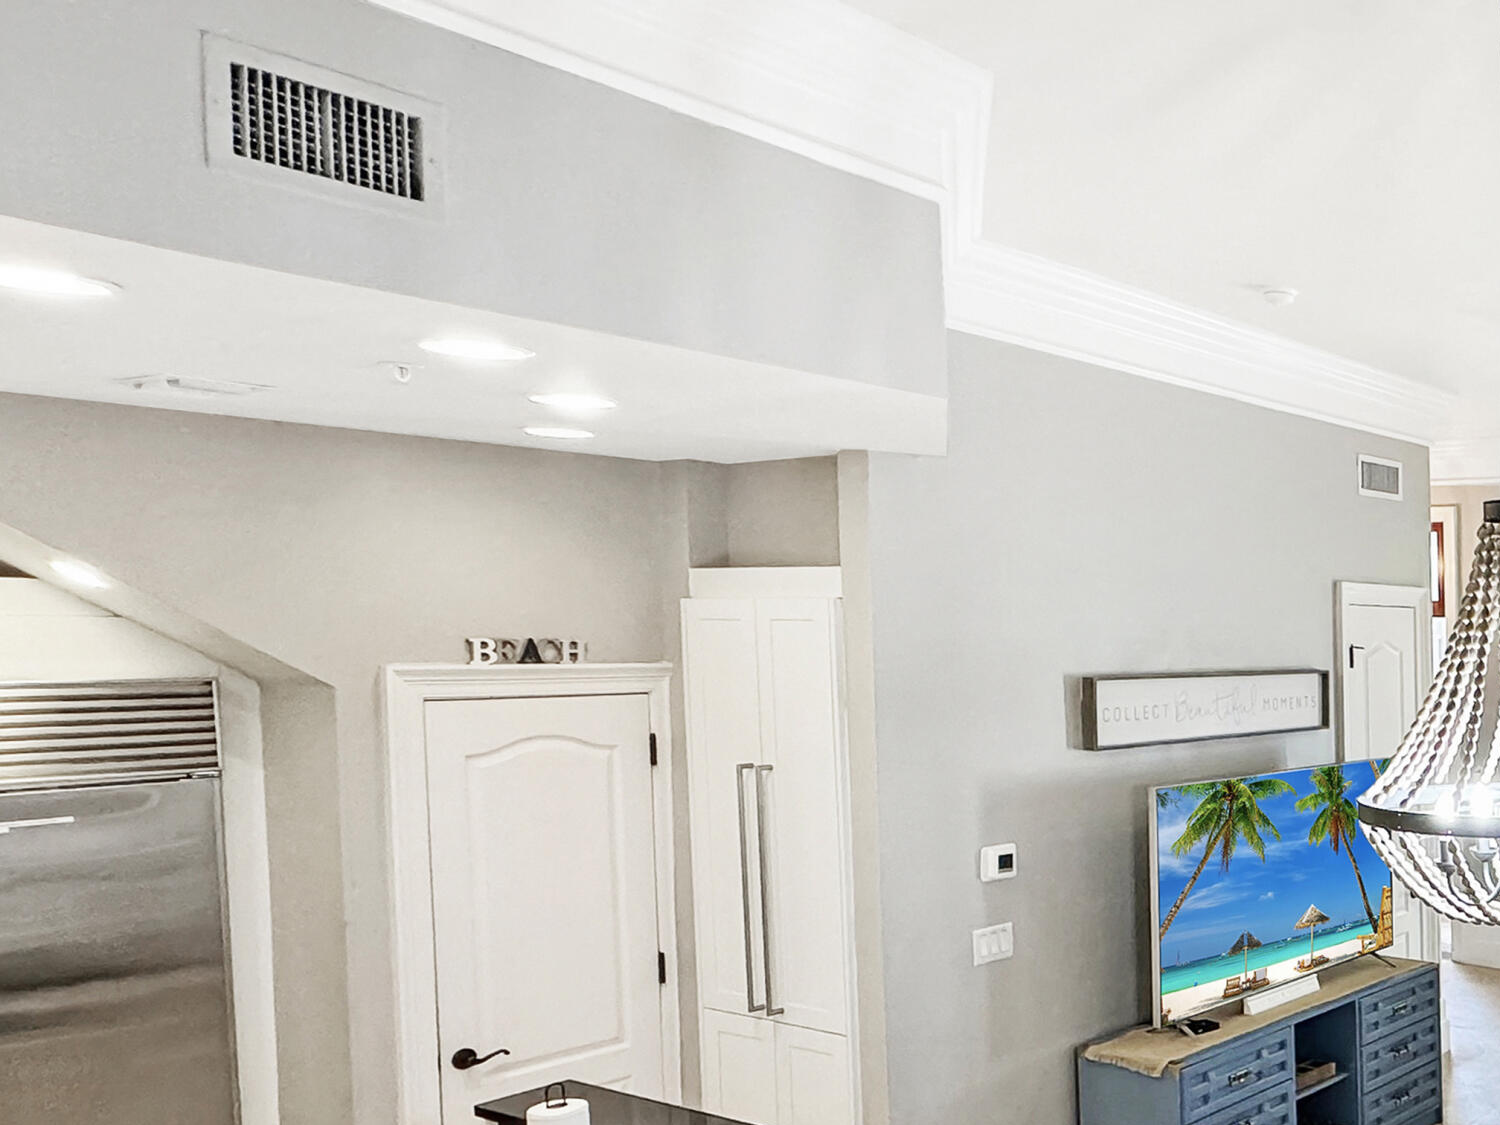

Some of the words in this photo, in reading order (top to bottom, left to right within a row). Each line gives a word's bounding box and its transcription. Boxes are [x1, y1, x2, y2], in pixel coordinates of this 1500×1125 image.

[465, 638, 587, 665] BEACH
[1102, 704, 1169, 723] COLLECT
[1262, 695, 1318, 711] MOMENTS
